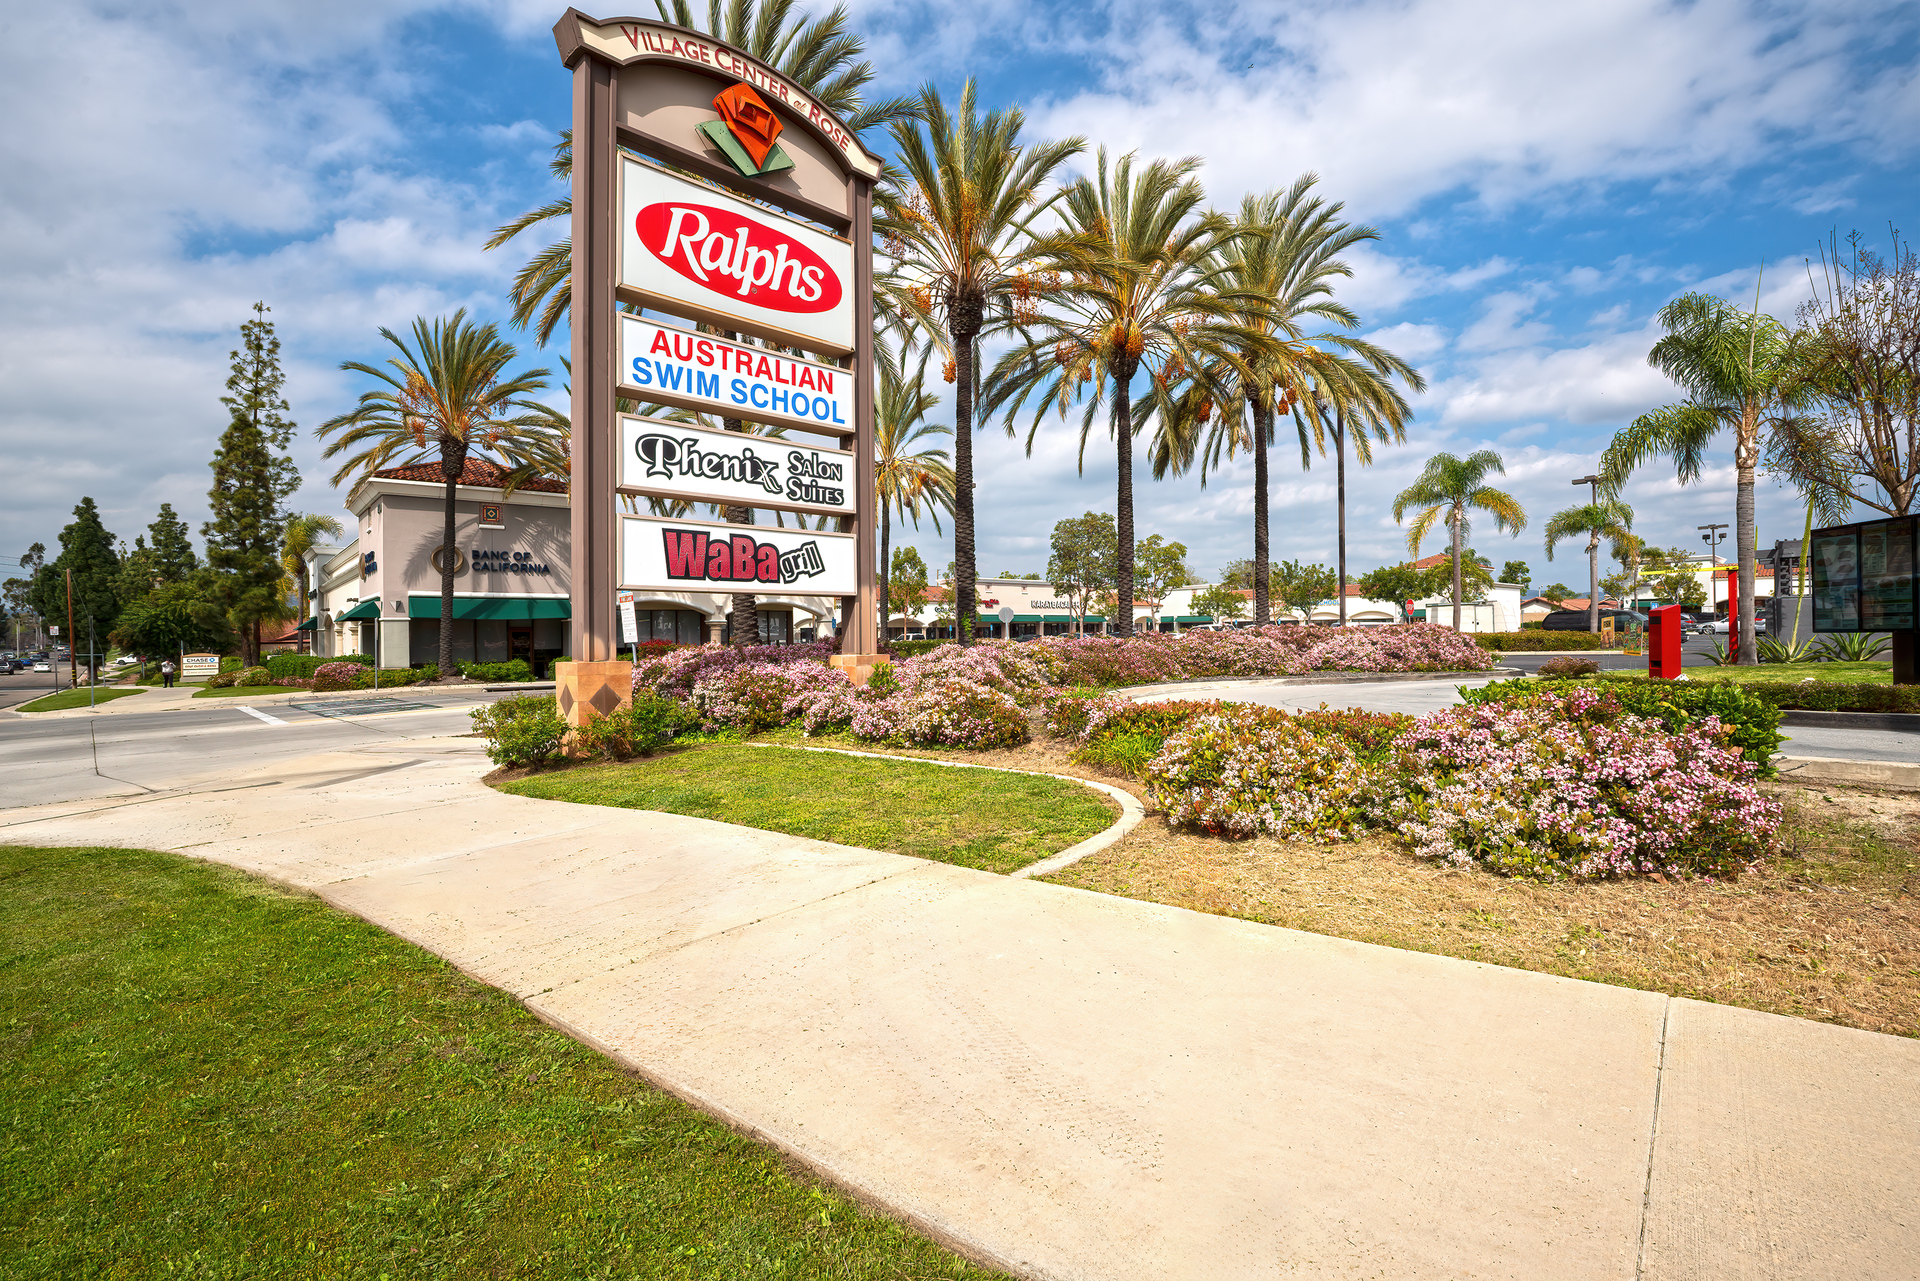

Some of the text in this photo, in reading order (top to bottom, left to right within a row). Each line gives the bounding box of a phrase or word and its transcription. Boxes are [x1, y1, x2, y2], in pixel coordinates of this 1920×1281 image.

[620, 25, 711, 64] VILLAGE
[715, 47, 789, 103] CENTER
[808, 103, 850, 152] ROSE
[660, 207, 825, 302] Ralphs
[632, 357, 845, 424] SWIM SCHOOL
[650, 330, 834, 394] AUSTRALIAN
[635, 433, 782, 494] Phenix
[472, 550, 531, 560] BANC OF
[472, 561, 550, 573] CALIFORNIA
[662, 528, 826, 584] WaBa grill
